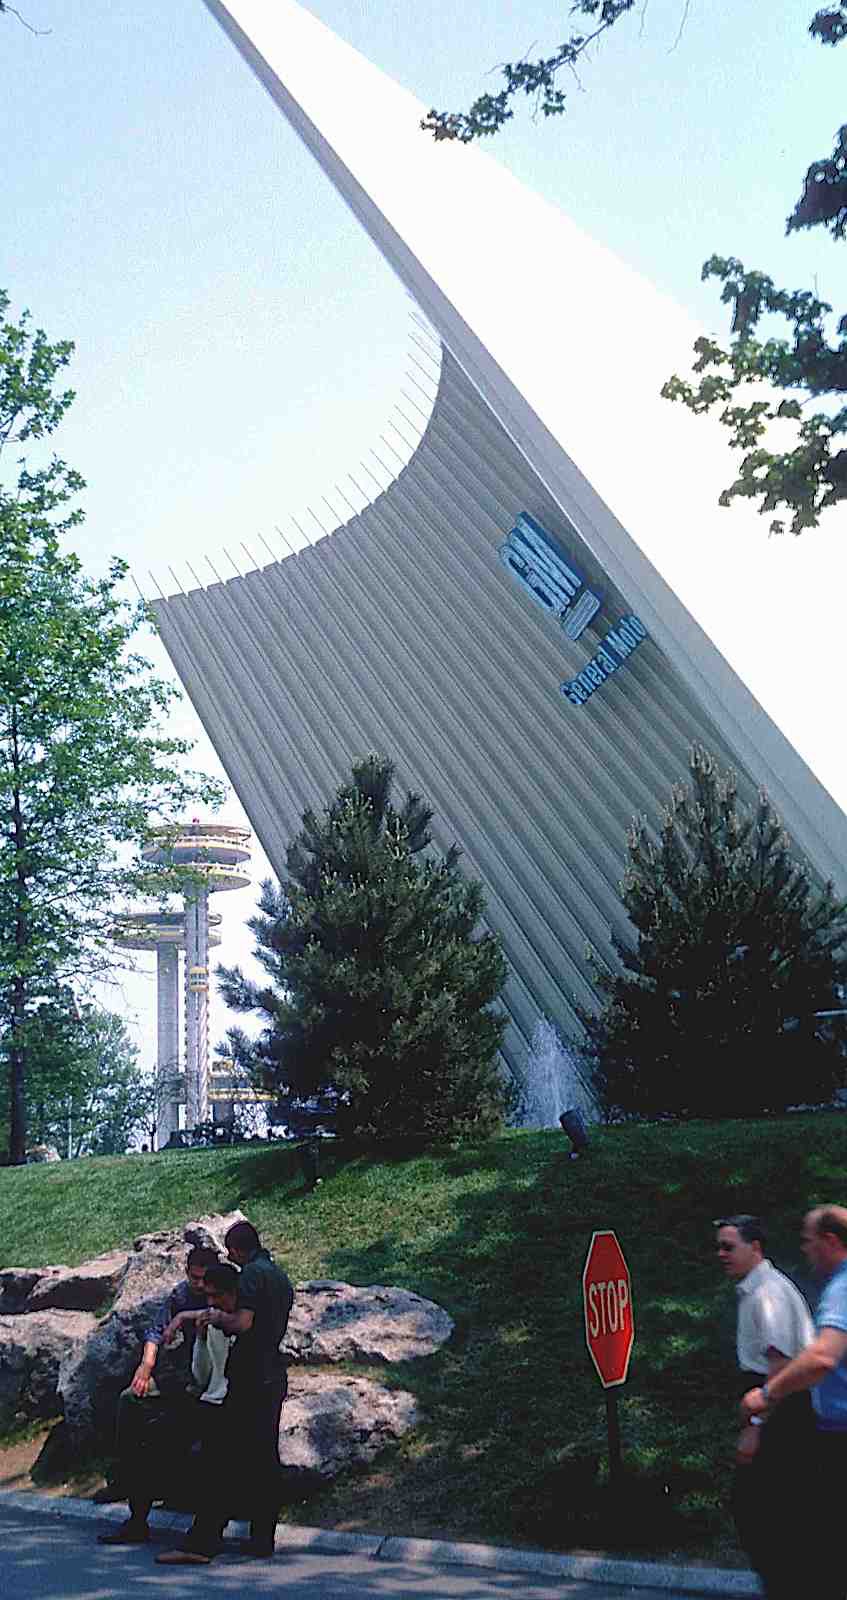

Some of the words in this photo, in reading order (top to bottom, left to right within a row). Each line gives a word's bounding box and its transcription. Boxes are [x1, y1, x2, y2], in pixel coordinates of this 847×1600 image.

[500, 512, 582, 616] GM
[561, 646, 618, 704] General
[606, 614, 647, 659] Moto
[589, 1279, 628, 1338] STOP
